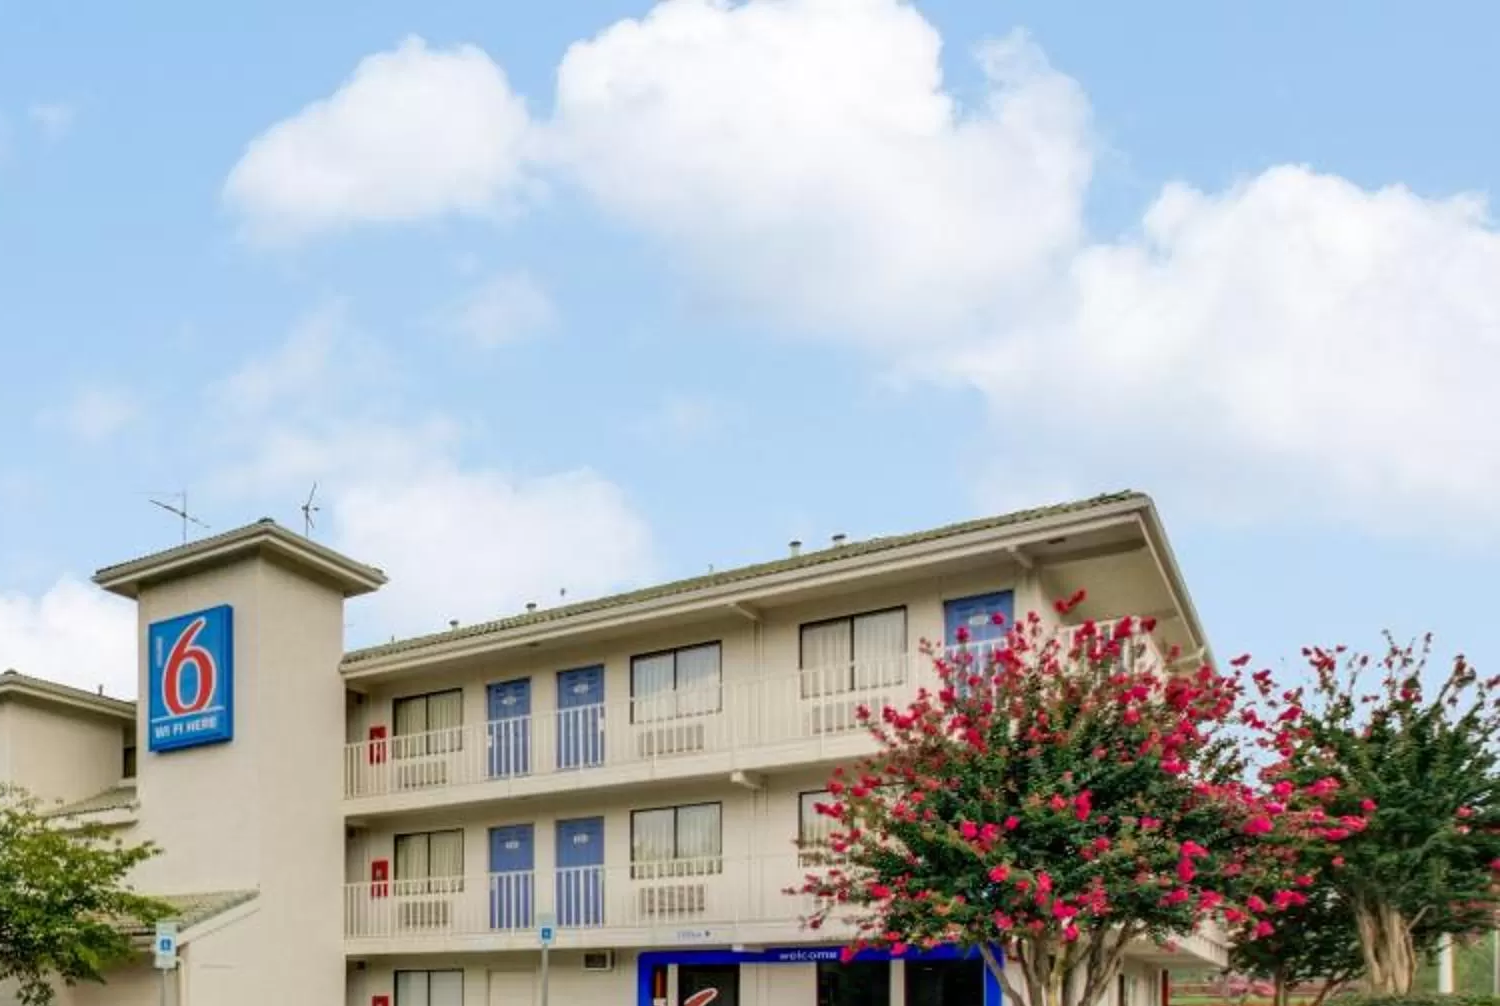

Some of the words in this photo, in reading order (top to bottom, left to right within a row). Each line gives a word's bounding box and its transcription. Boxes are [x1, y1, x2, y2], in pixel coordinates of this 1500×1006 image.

[163, 617, 216, 717] 6
[173, 723, 184, 736] FI
[186, 716, 217, 732] HERE
[779, 949, 838, 961] welcome
